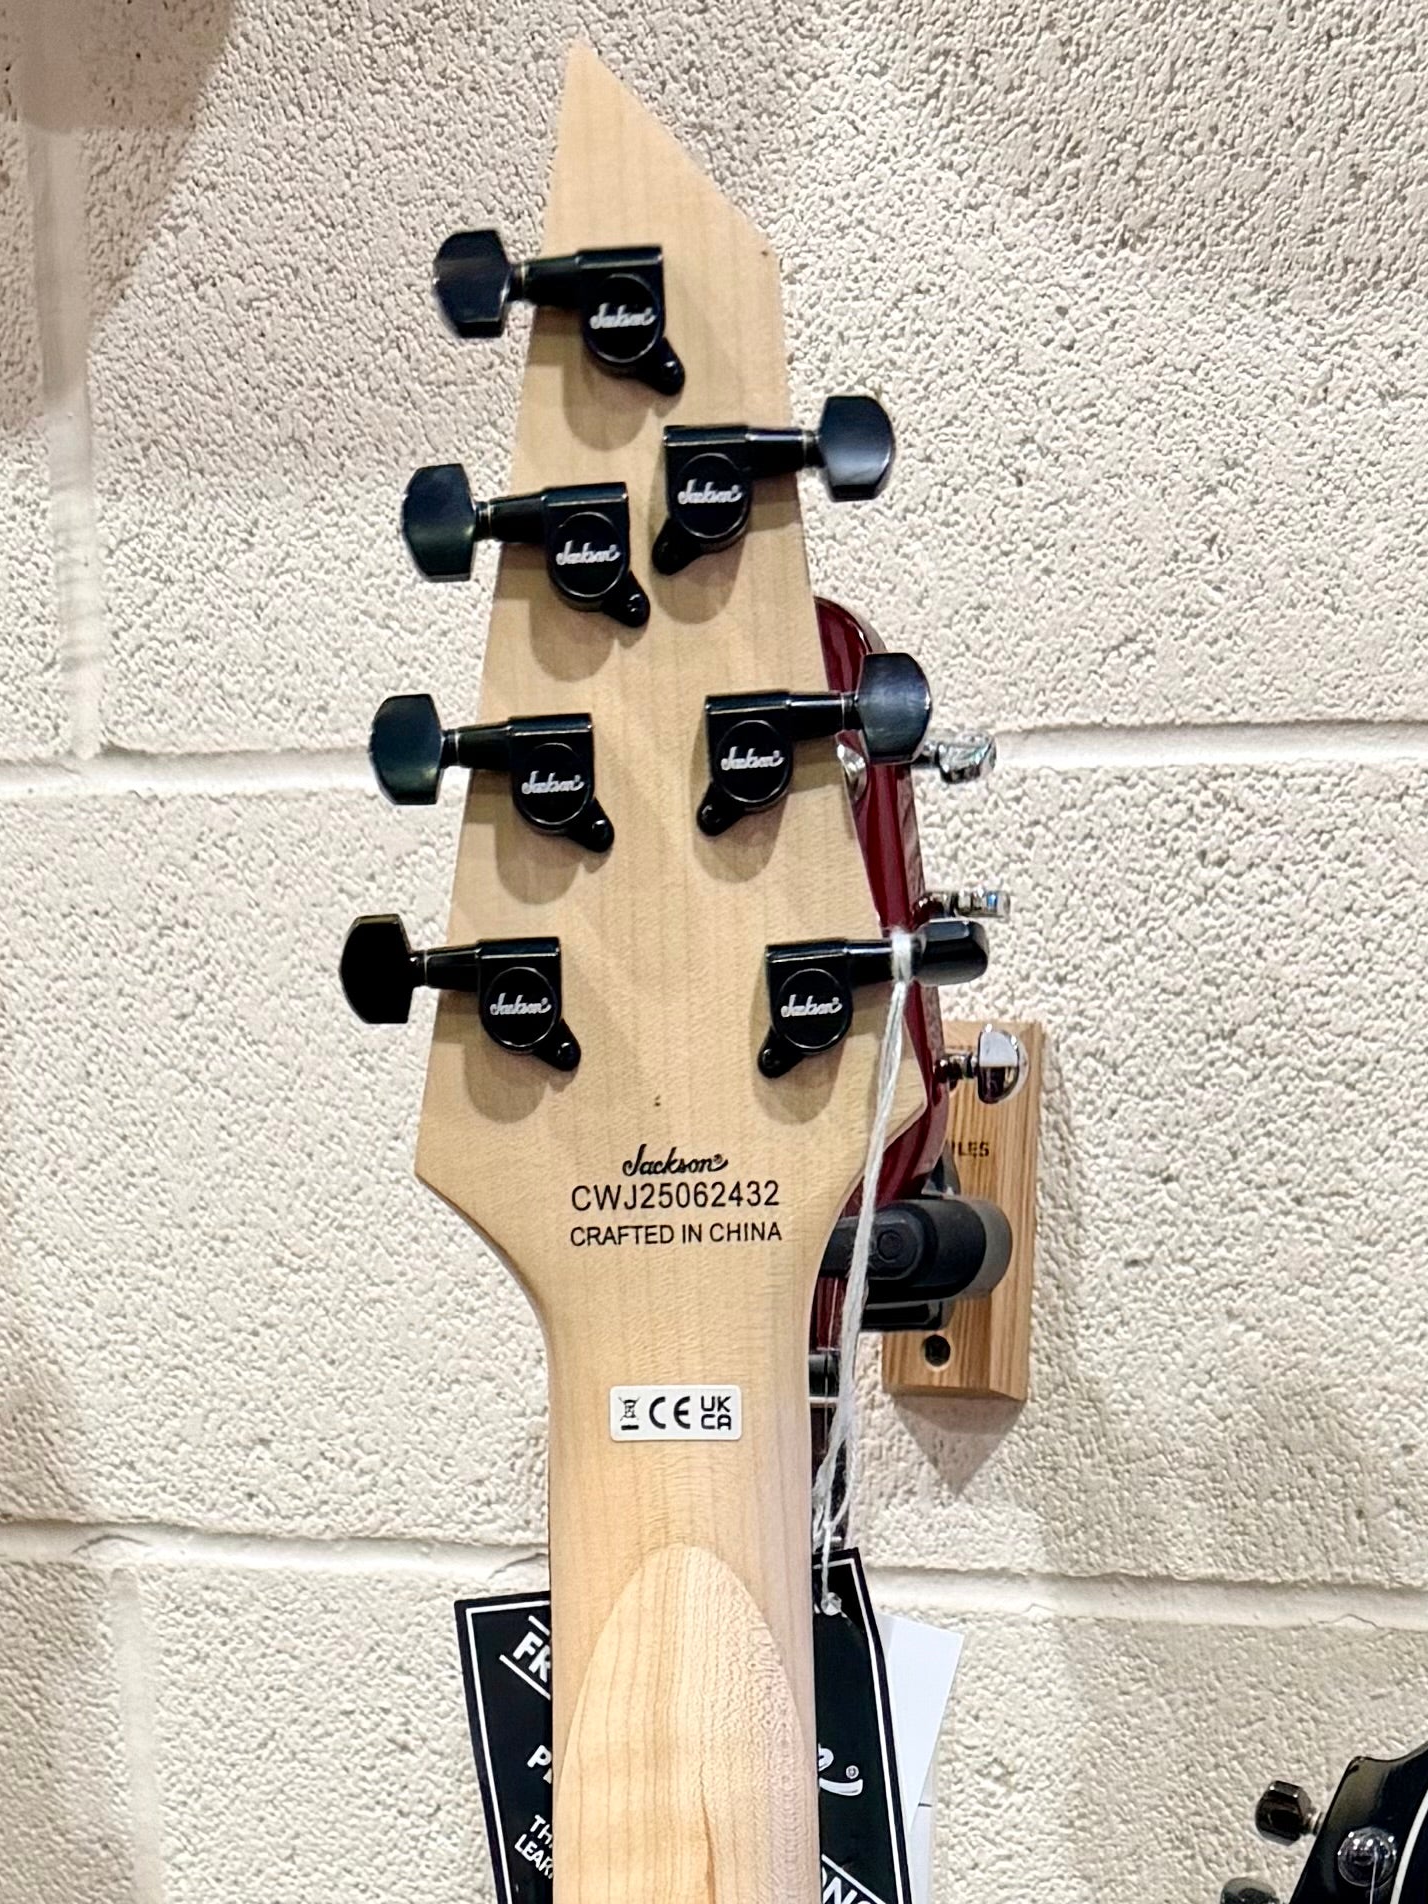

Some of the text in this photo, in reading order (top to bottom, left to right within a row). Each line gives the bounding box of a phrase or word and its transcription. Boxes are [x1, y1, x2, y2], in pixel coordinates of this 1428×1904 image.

[571, 1179, 780, 1212] CWJ25062432
[570, 1221, 783, 1247] CRAFTED IN CHINA
